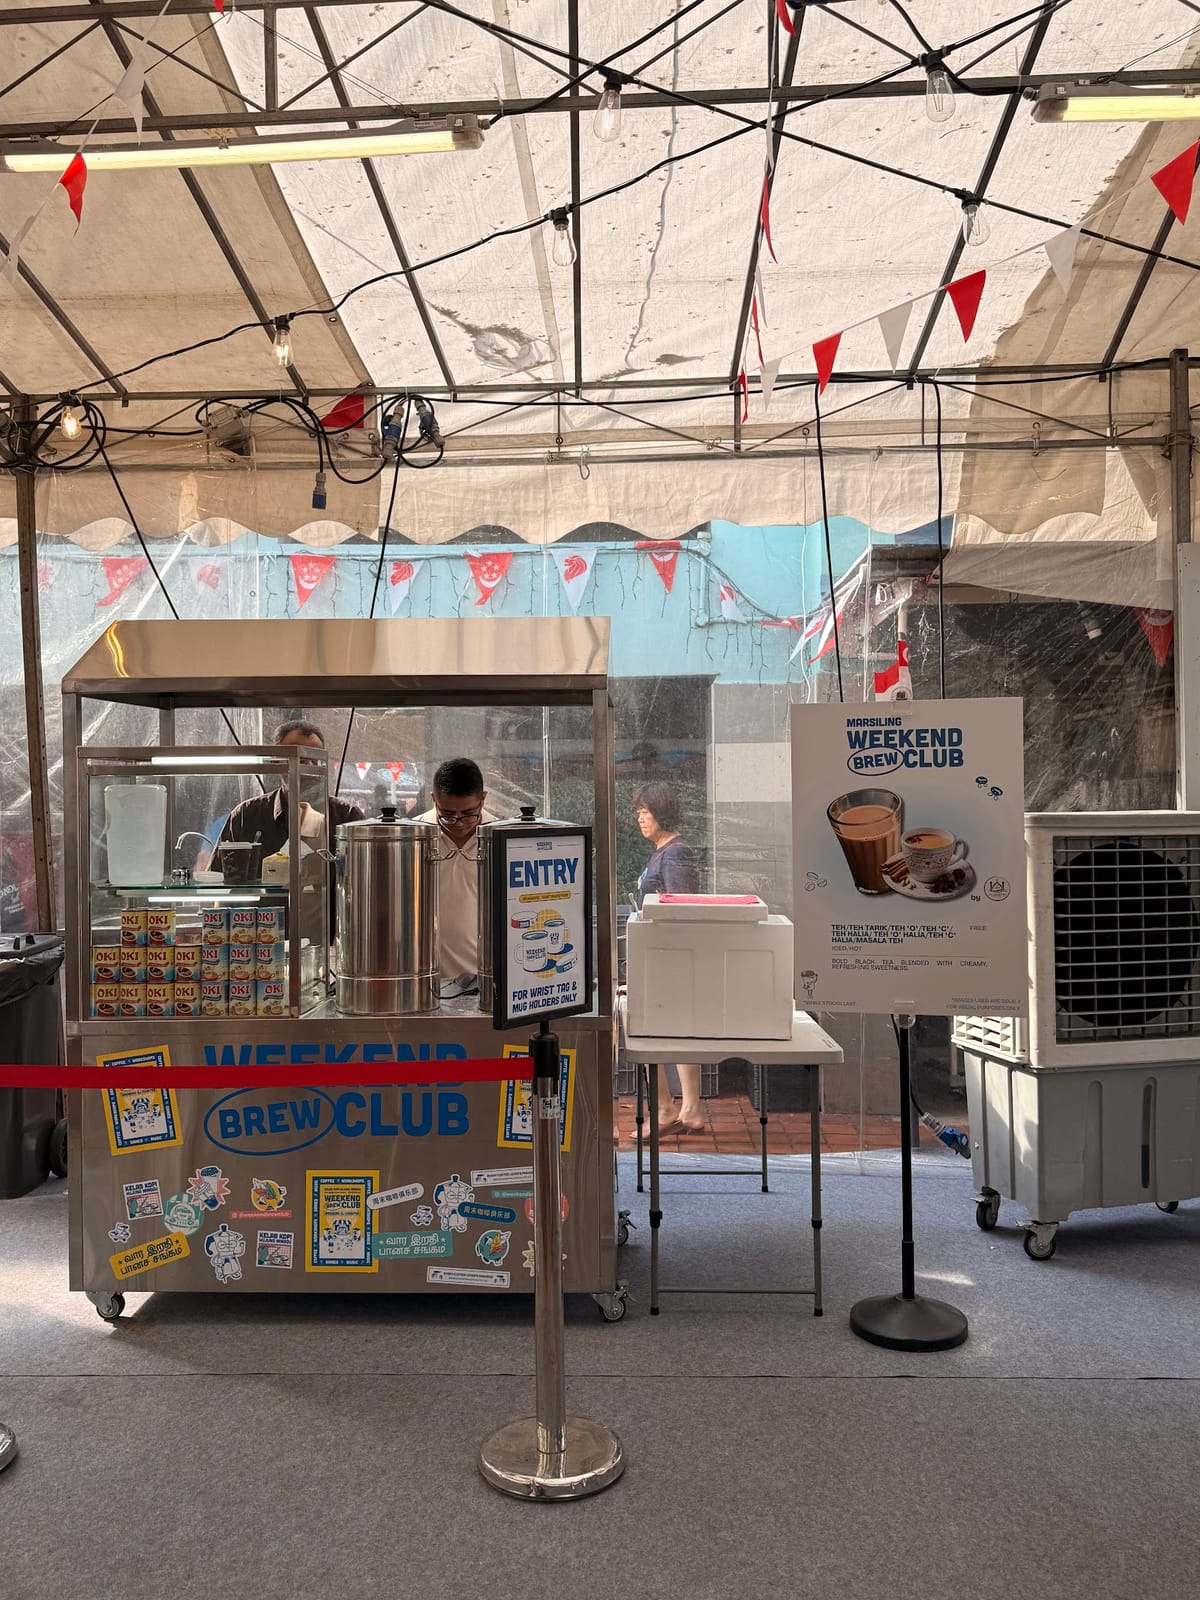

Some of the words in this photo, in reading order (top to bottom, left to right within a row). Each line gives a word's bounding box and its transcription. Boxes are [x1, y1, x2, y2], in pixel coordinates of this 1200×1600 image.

[846, 717, 902, 728] MARSILING
[846, 728, 962, 750] WEEKEND
[853, 752, 898, 770] BREW
[904, 748, 964, 768] CLUB
[510, 858, 578, 888] ENTRY
[122, 916, 139, 924] OKI
[149, 916, 168, 924] OKI
[204, 913, 222, 922] OKI
[234, 912, 252, 922] OKI
[96, 952, 116, 961] OKI
[121, 952, 139, 961] OKI
[148, 952, 167, 961] OKI
[176, 951, 195, 960] OKI
[231, 949, 250, 958] OKI
[258, 949, 271, 958] KI
[97, 988, 116, 997] OKI
[120, 988, 138, 997] OKI
[148, 988, 167, 997] OKI
[176, 987, 194, 996] OKI
[231, 986, 250, 994] OKI
[512, 990, 528, 1001] FOR
[530, 985, 554, 998] WRIST
[556, 983, 570, 994] TAG
[572, 981, 577, 991] &
[512, 1002, 527, 1013] MUG
[529, 997, 559, 1010] HOLDERS
[561, 993, 577, 1004] ONLY
[218, 1098, 321, 1140] BREW
[334, 1092, 470, 1138] CLUB
